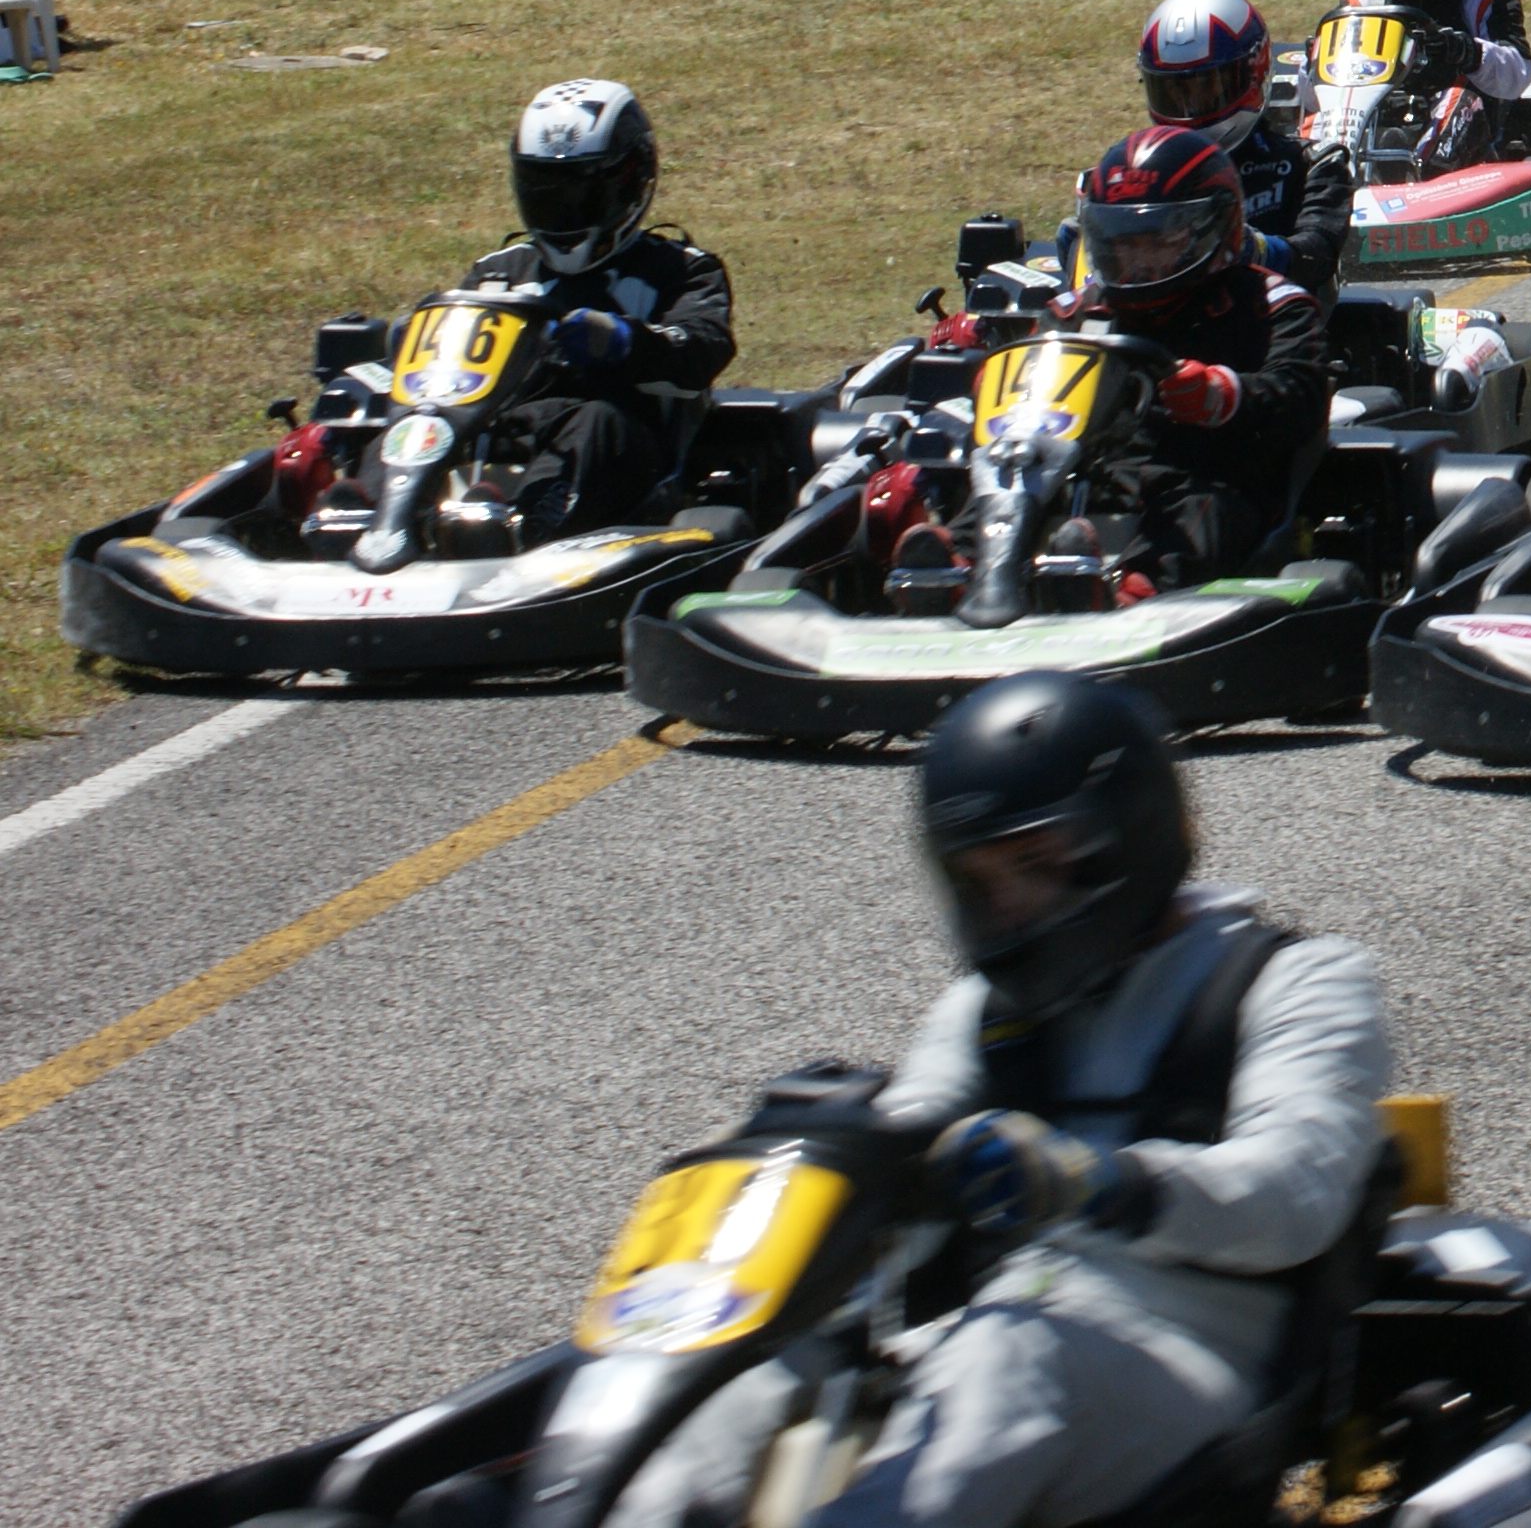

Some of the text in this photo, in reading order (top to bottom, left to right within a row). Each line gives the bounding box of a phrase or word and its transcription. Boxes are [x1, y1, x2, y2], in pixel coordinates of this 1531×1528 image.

[1368, 219, 1489, 256] RIELLO
[408, 308, 501, 364] 146
[993, 345, 1099, 408] 147
